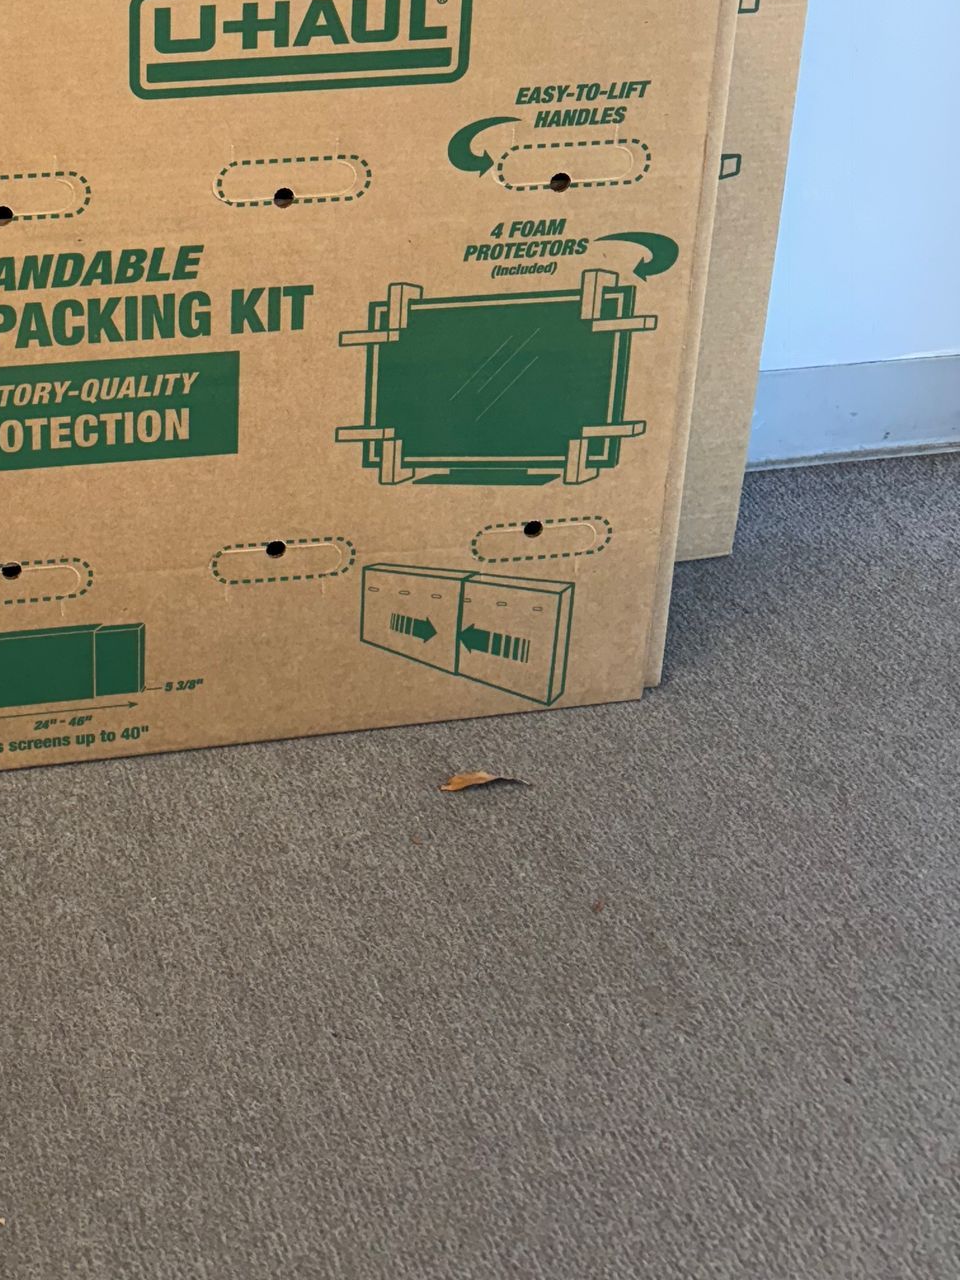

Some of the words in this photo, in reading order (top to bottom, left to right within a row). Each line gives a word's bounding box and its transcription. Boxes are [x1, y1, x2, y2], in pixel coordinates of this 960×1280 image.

[515, 80, 652, 105] EASY-TO-LIFT
[533, 106, 627, 129] HANDLES
[489, 222, 505, 239] 4
[508, 218, 567, 239] FOAM
[462, 238, 590, 262] PROTECTORS
[230, 284, 315, 335] KIT
[33, 717, 57, 731] 24"
[9, 735, 71, 751] screens
[75, 733, 96, 747] up
[100, 730, 116, 743] to
[120, 725, 150, 741] 40"
